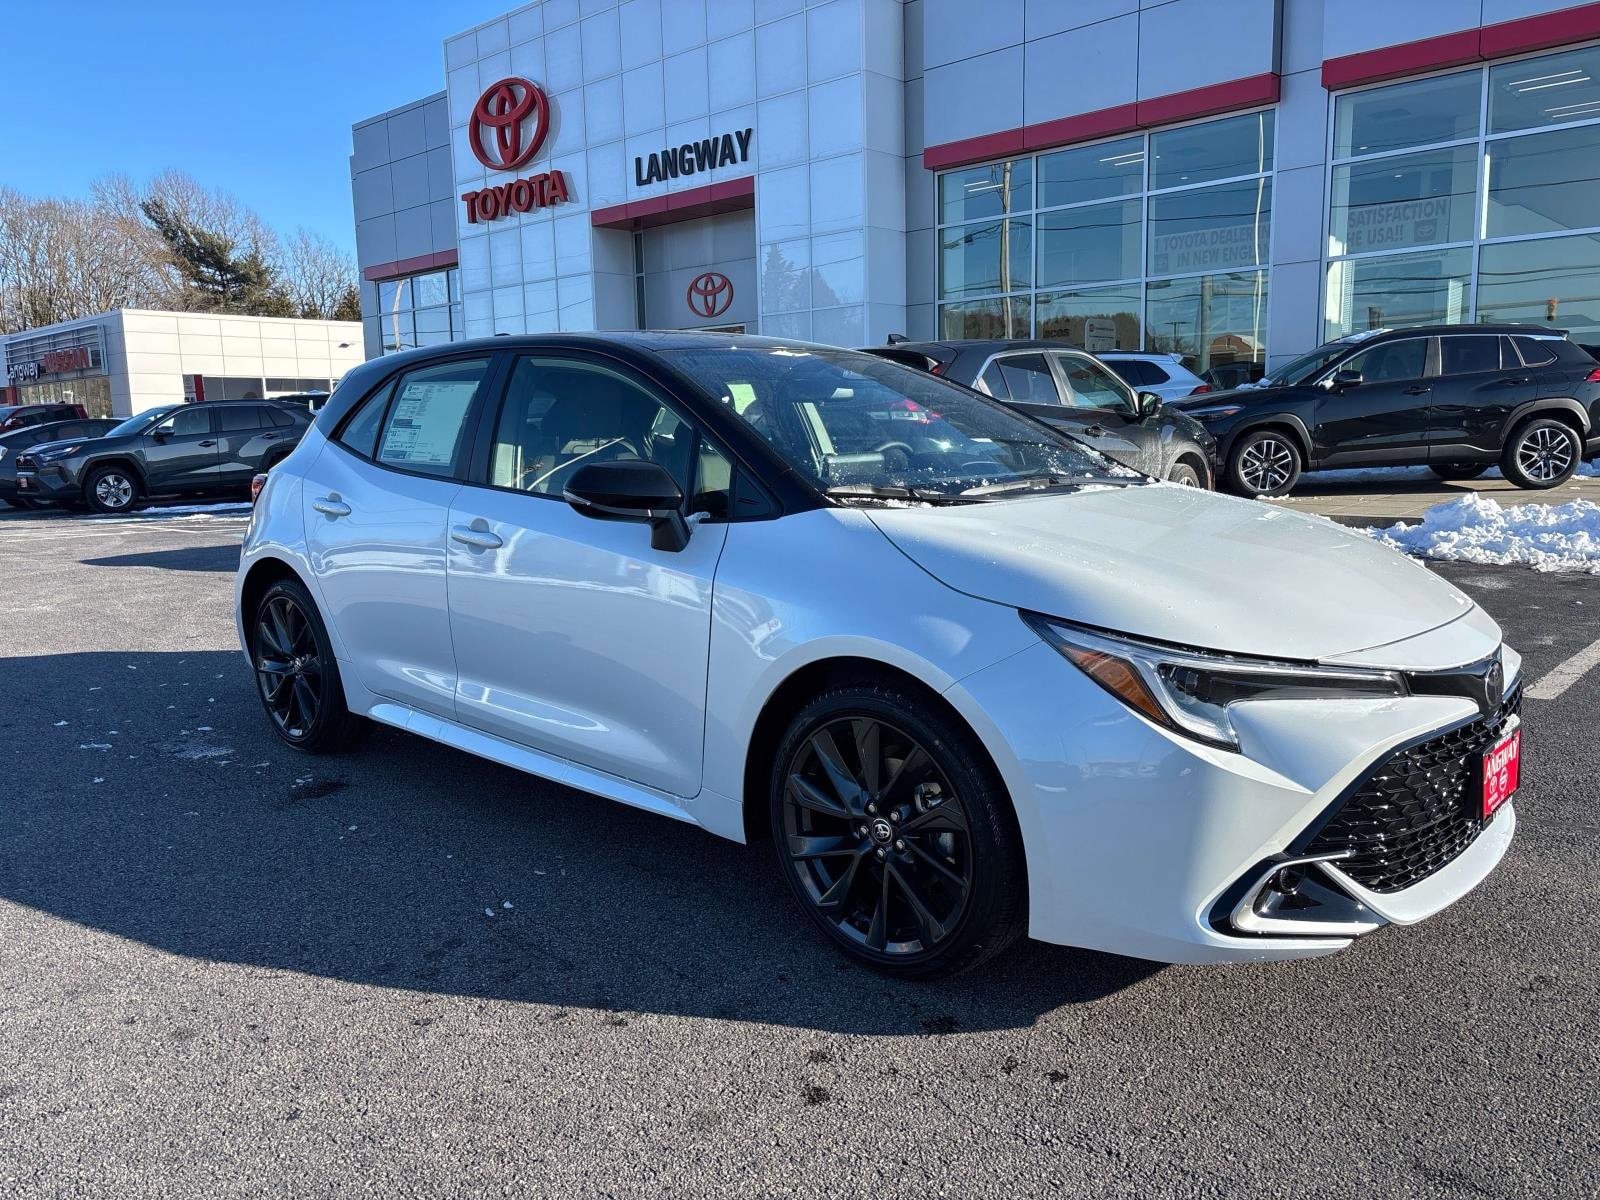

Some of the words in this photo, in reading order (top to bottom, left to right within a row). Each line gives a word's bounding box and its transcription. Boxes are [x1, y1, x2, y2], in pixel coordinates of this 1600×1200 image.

[635, 128, 752, 187] LANGWAY
[462, 170, 568, 224] TOYOTA
[1348, 199, 1447, 228] SATISFACTION
[1164, 231, 1207, 251] TOYOTA
[1367, 223, 1404, 245] USA!!
[1192, 247, 1219, 266] NEW
